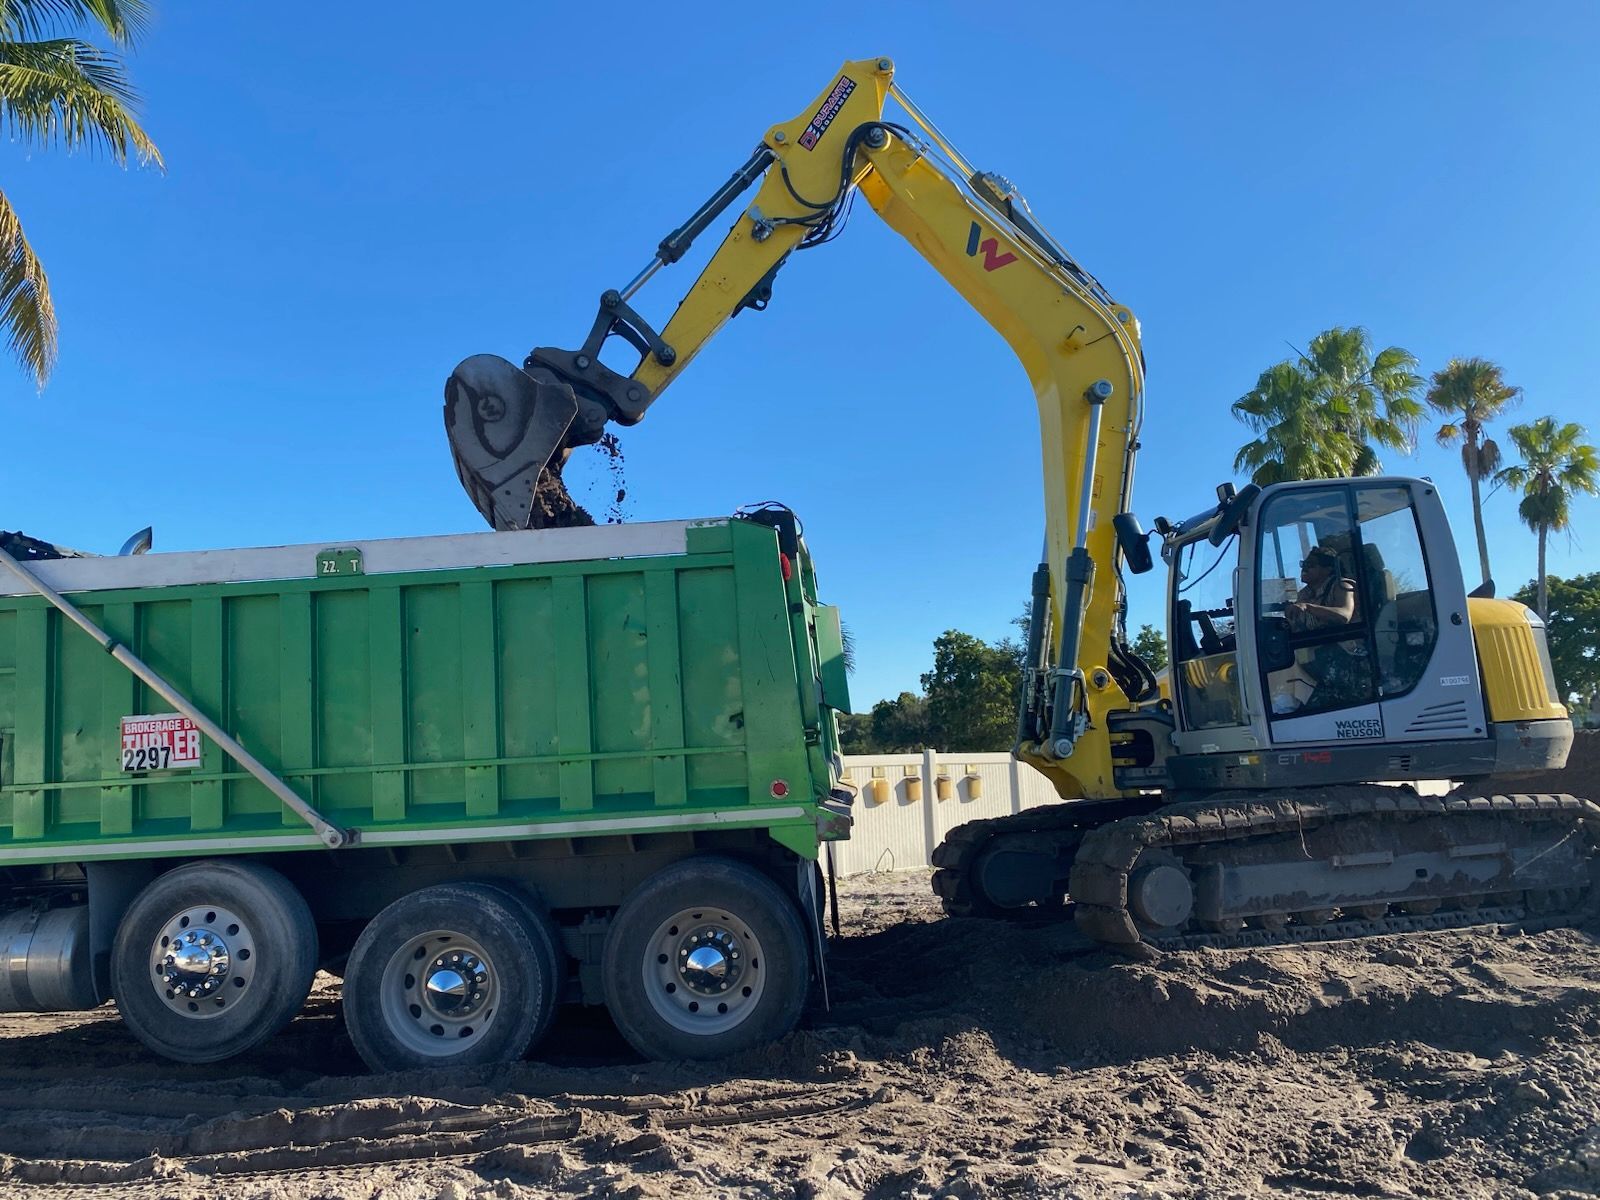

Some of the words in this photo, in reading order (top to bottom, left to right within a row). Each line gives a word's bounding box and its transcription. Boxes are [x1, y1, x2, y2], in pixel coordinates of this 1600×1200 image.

[813, 76, 850, 127] DURANTE
[821, 82, 855, 131] EQUIPMENT
[350, 559, 359, 572] T
[125, 720, 181, 734] BROKERAGE
[1335, 719, 1380, 729] WACKER
[1336, 728, 1382, 738] NEUSON
[124, 746, 170, 771] 2297
[1278, 753, 1301, 765] ET
